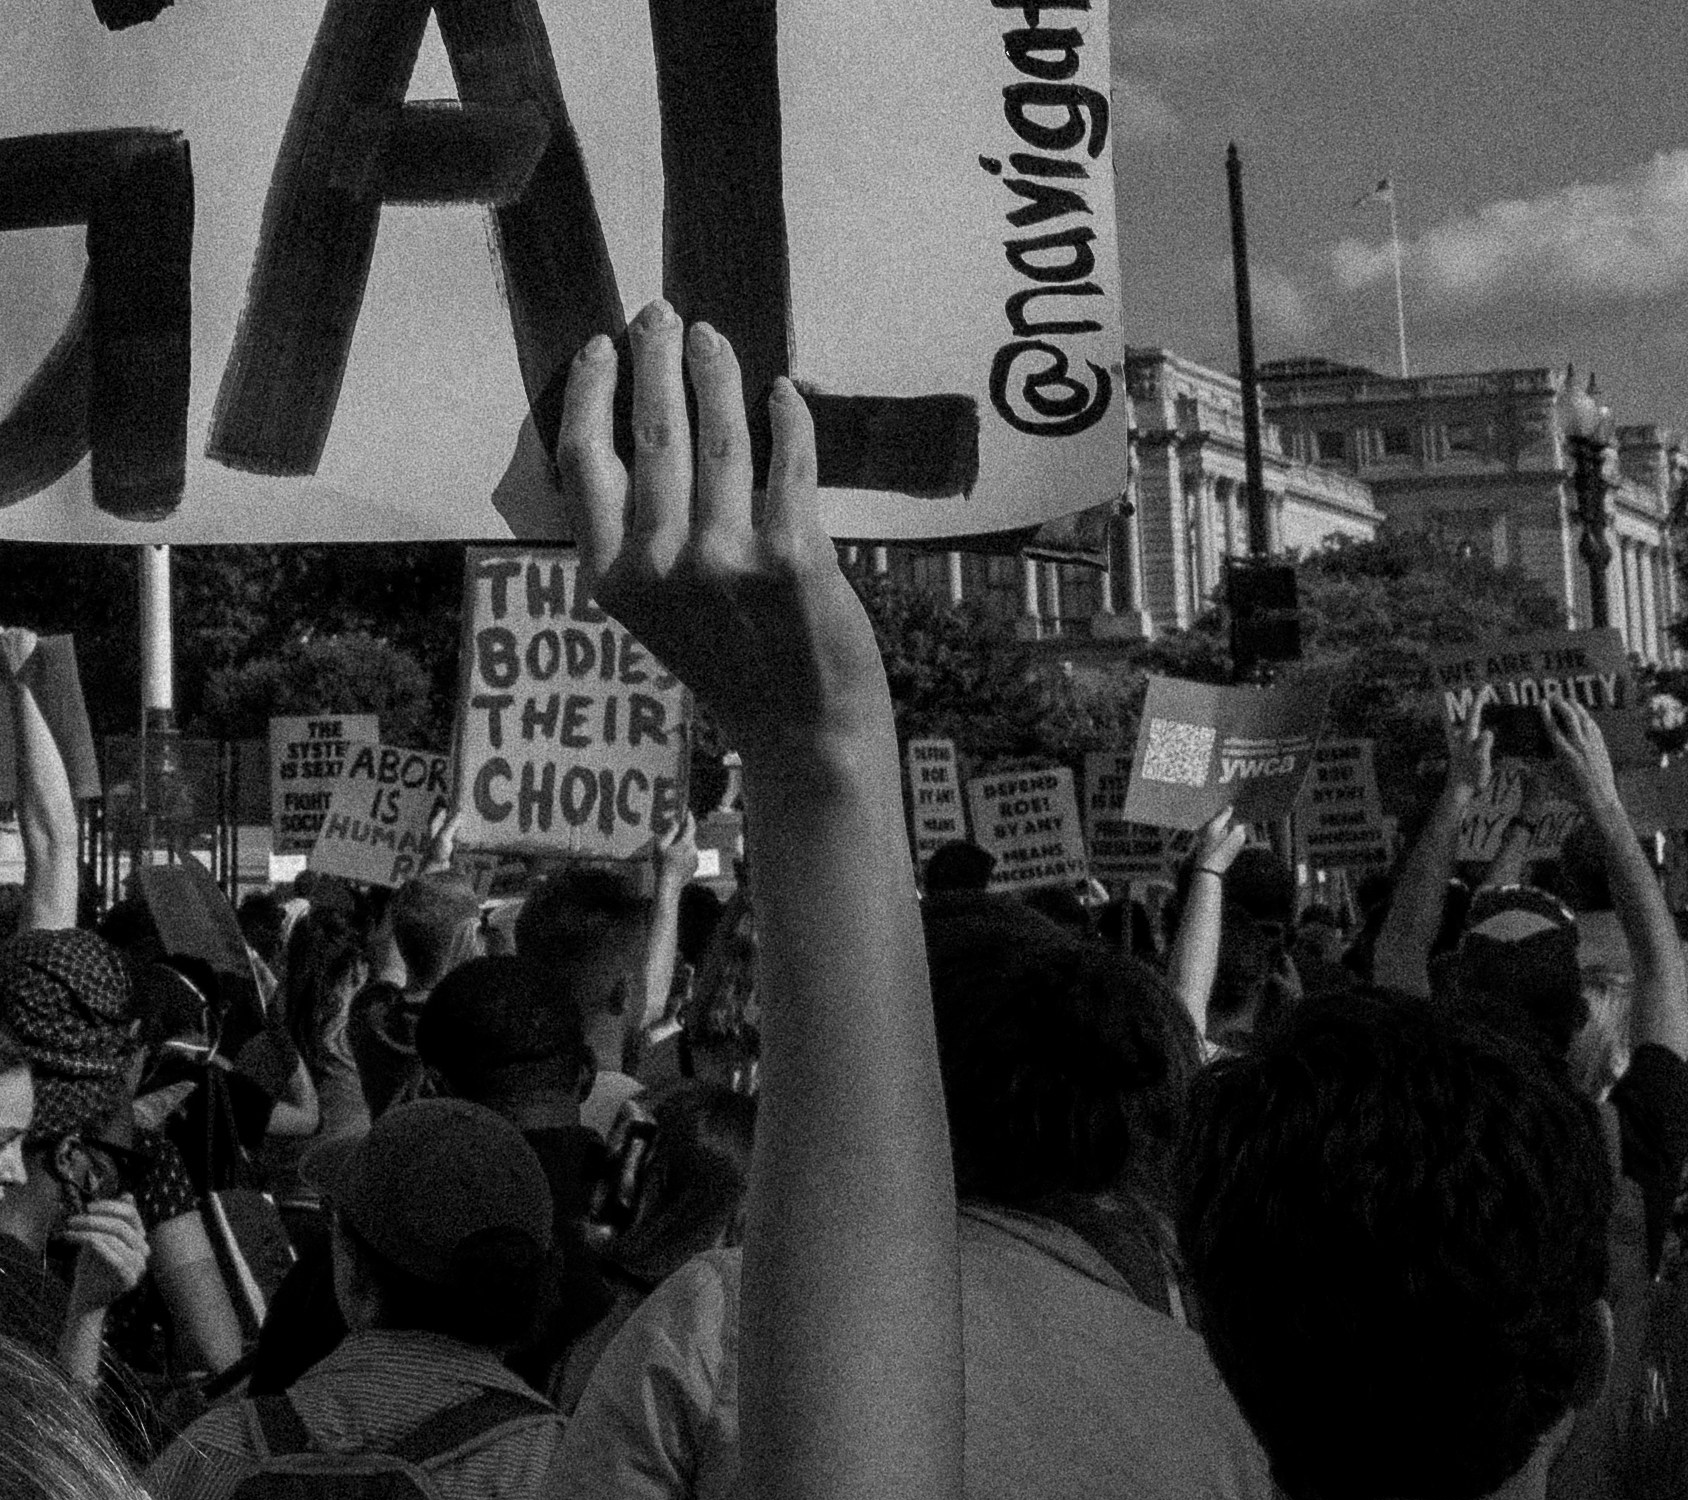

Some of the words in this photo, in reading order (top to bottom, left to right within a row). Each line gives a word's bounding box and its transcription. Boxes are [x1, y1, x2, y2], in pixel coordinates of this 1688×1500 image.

[476, 627, 678, 691] BODIE
[1439, 659, 1475, 684] WE
[1487, 653, 1531, 675] ARE
[1540, 648, 1587, 670] THE
[307, 721, 342, 738] THE
[471, 694, 671, 749] THEIR
[287, 741, 350, 759] SYSTE
[1218, 755, 1296, 784] ywca
[371, 788, 400, 824] IS
[474, 757, 682, 836] CHOICE
[994, 823, 1018, 839] BY
[1024, 818, 1064, 835] ANY
[1003, 844, 1064, 863] MEANS
